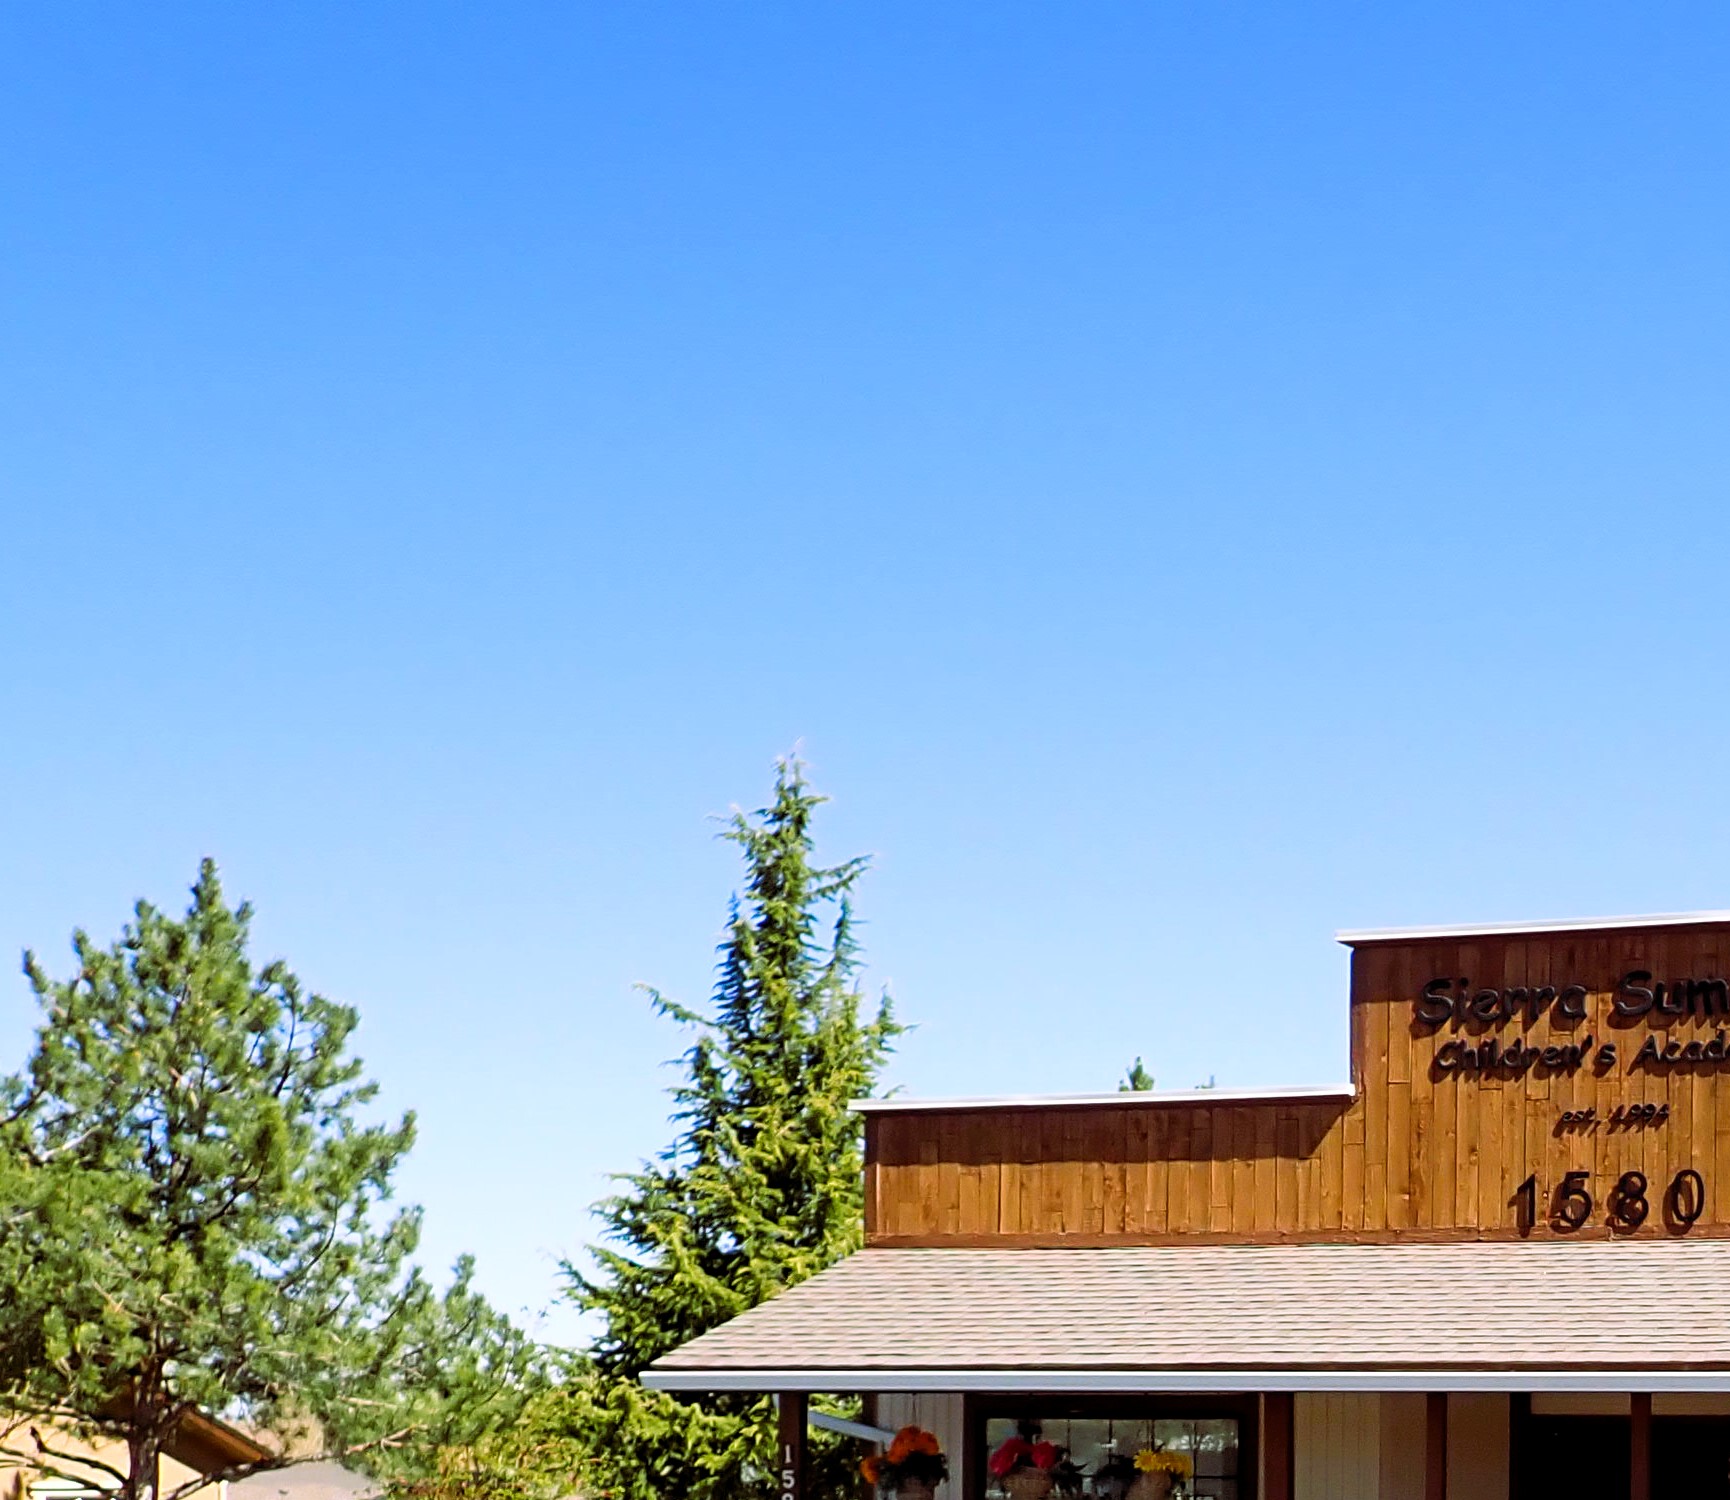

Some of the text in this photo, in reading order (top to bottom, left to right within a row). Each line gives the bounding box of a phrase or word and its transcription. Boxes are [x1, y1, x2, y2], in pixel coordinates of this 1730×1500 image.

[1418, 977, 1587, 1024] Sierra
[1437, 1035, 1616, 1070] Children's
[1516, 1169, 1704, 1228] 1580
